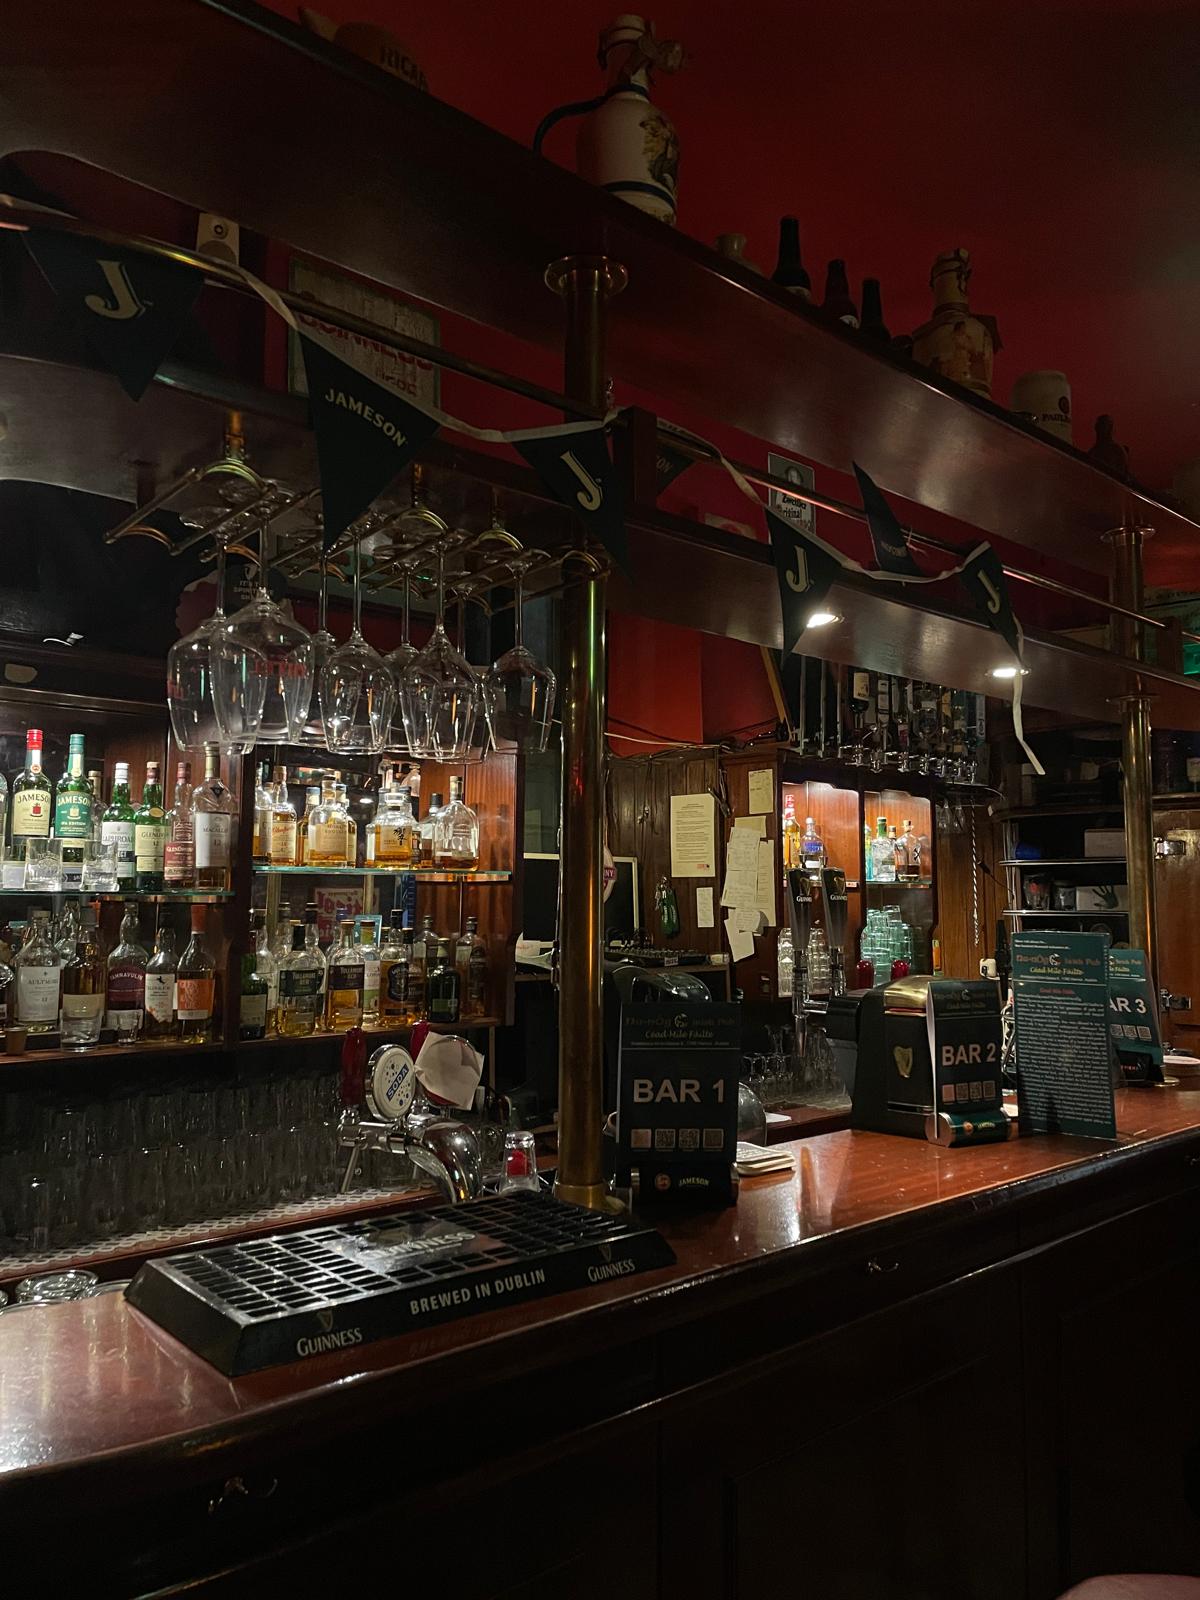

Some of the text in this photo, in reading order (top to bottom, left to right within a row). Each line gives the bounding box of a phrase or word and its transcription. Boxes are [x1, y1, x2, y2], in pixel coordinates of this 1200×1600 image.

[84, 260, 146, 320] J
[324, 388, 408, 448] JAMESON
[560, 448, 603, 512] J
[785, 544, 811, 593] J
[18, 793, 49, 804] JAMESO
[1109, 997, 1147, 1014] AR 3
[941, 1042, 997, 1067] BAR 2
[387, 1067, 408, 1098] SODA
[633, 1079, 726, 1104] BAR 1
[587, 1258, 636, 1283] GUINNESS
[409, 1268, 546, 1316] BREWED IN DUBLIN
[296, 1327, 364, 1357] GUINNESS
